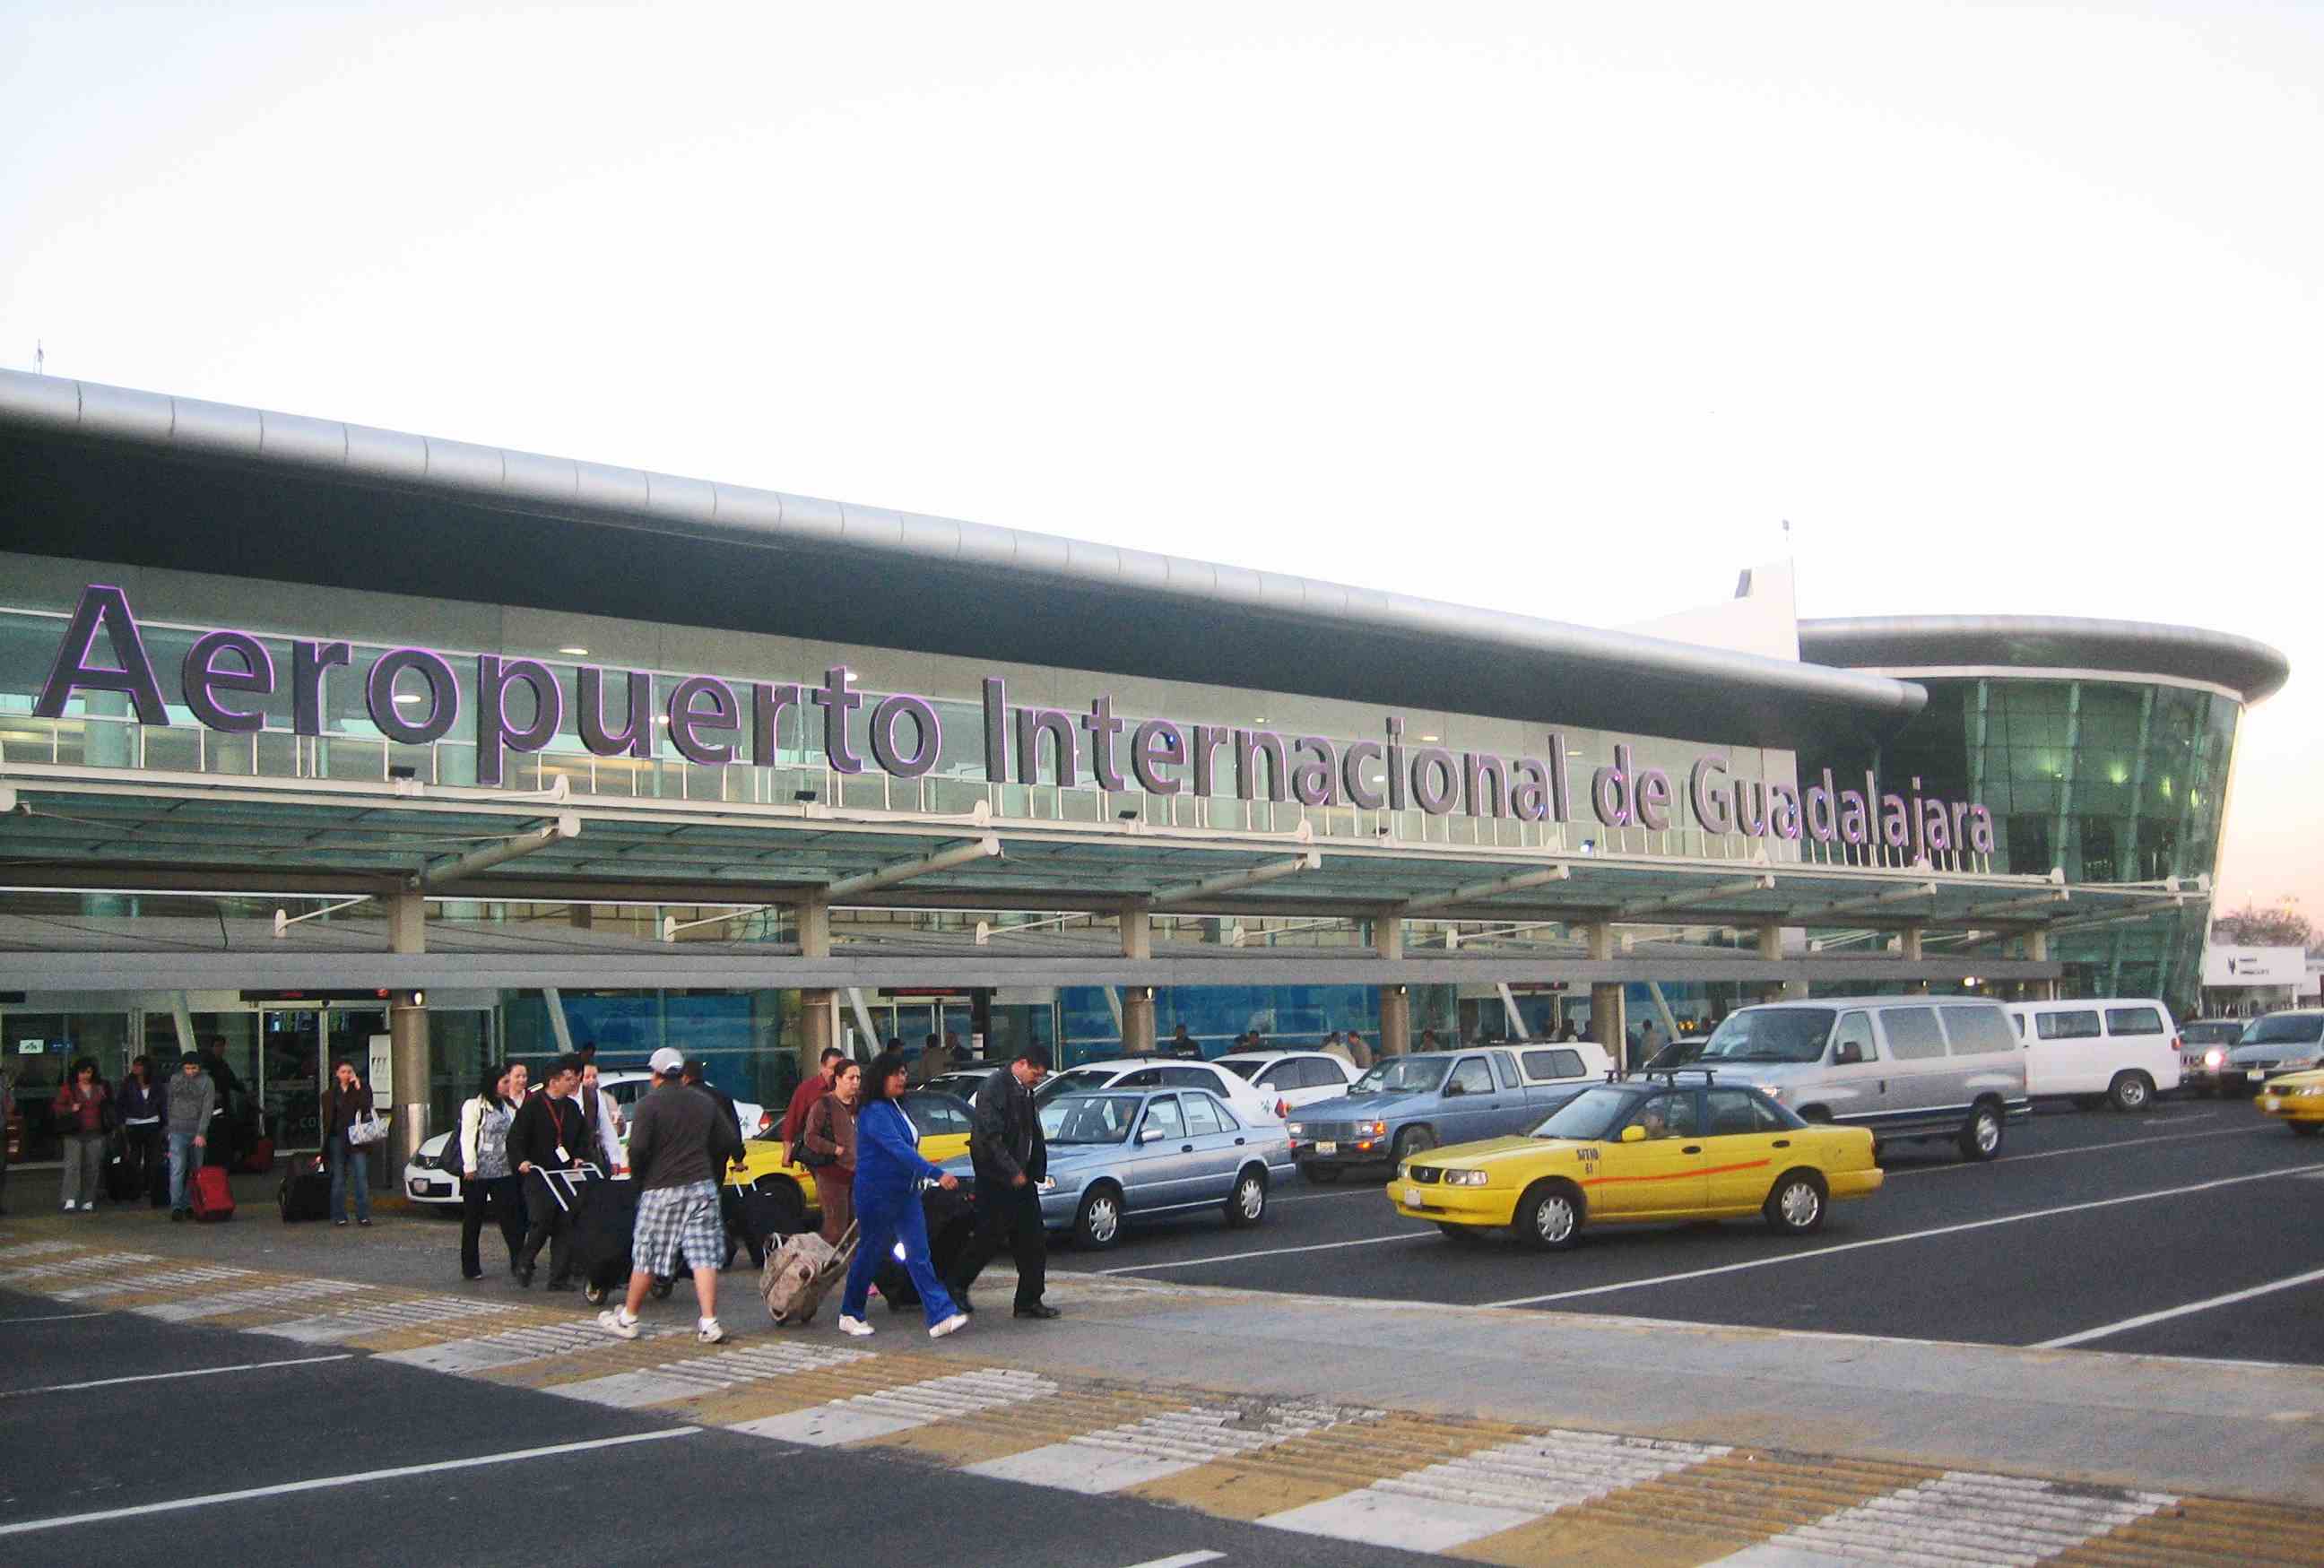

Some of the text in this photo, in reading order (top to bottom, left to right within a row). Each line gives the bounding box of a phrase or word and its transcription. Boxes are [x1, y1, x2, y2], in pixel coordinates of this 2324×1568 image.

[32, 585, 1994, 860] Aeropuerto Internacional de Guadalajara
